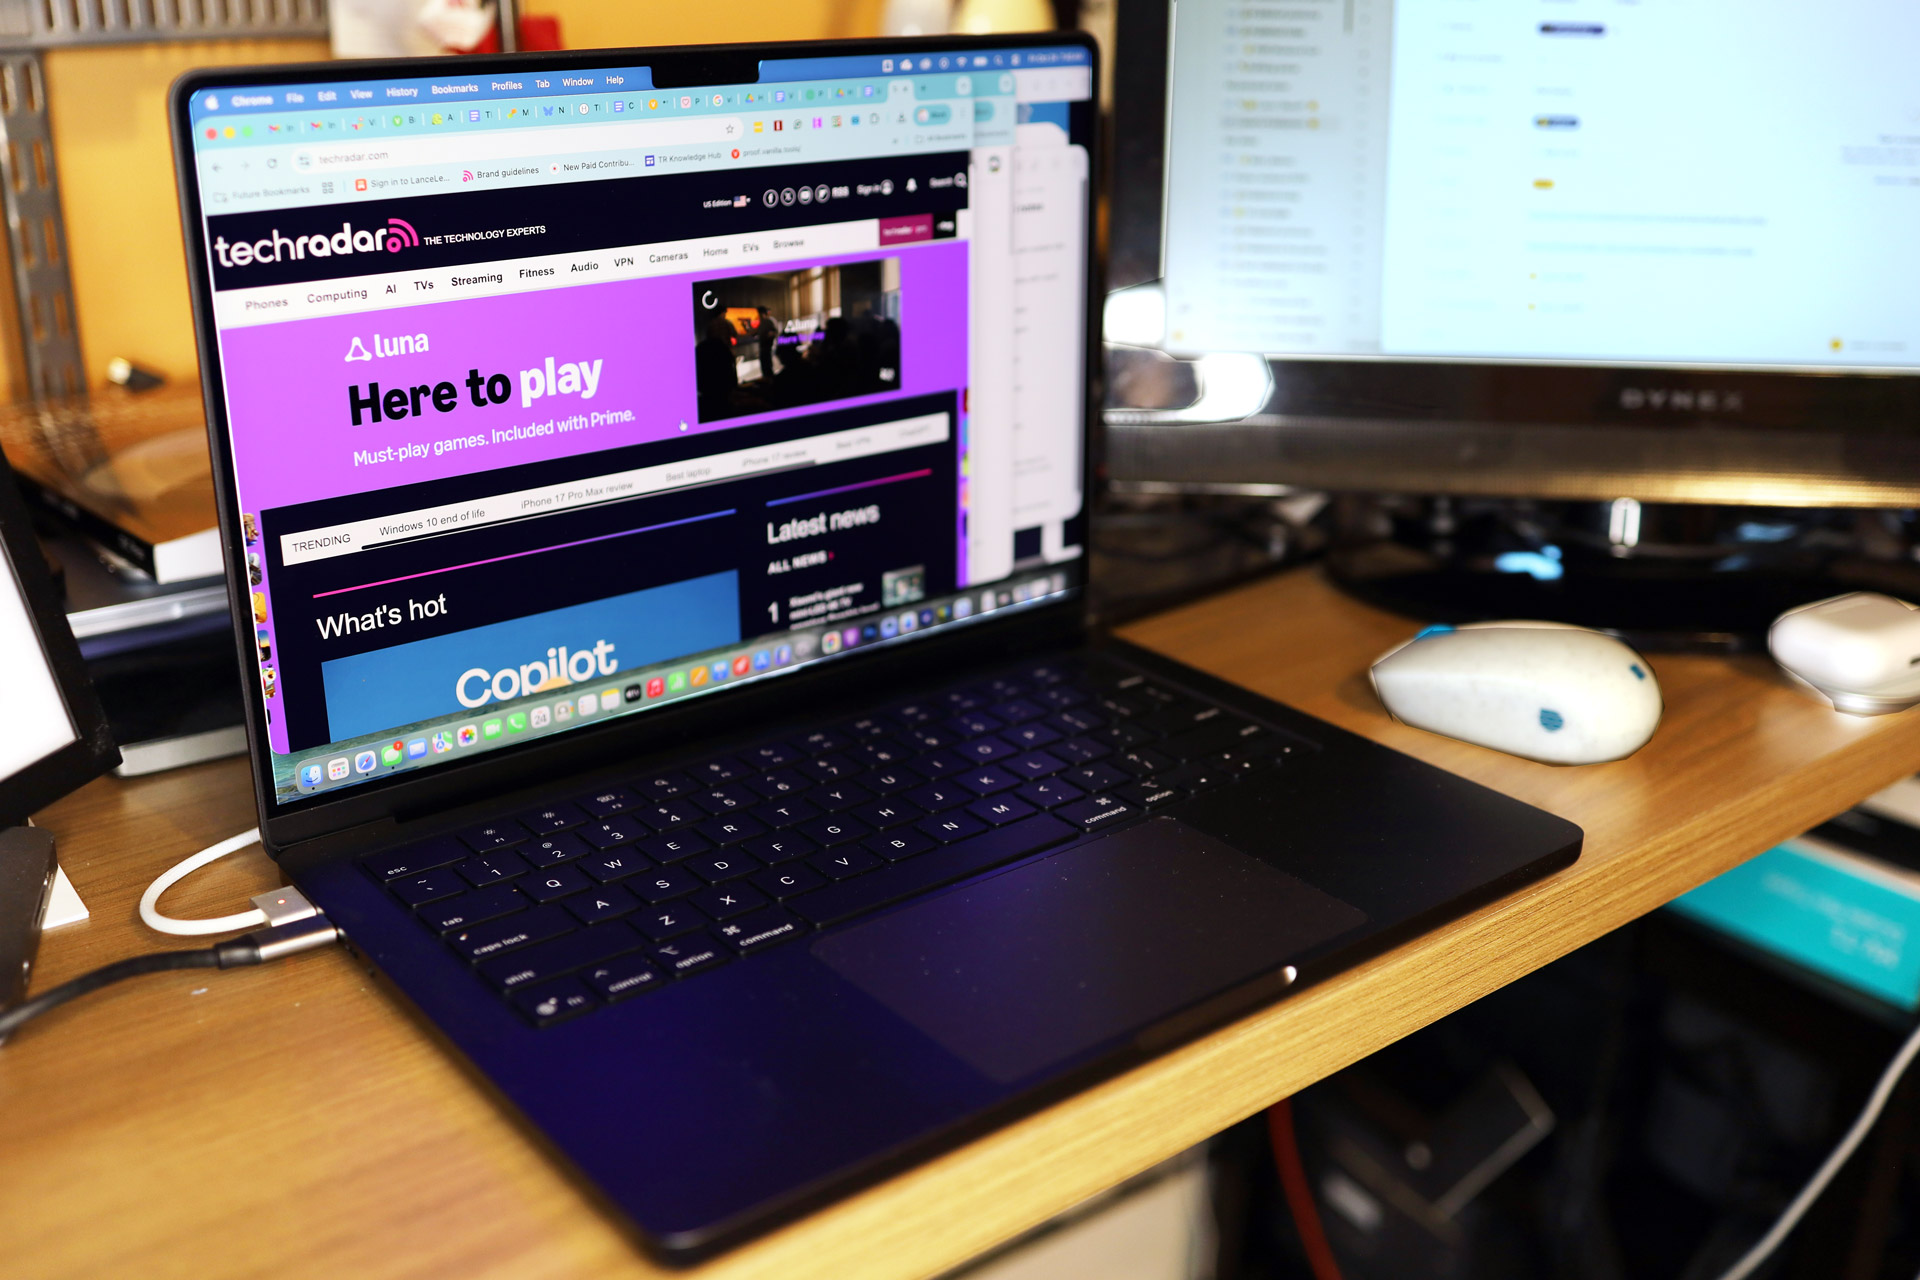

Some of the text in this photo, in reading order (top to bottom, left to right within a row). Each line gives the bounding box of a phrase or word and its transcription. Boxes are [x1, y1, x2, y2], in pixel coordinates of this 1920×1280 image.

[491, 80, 523, 92] Profiles
[535, 79, 551, 89] Tab
[562, 76, 594, 88] Window
[606, 75, 624, 86] Help
[350, 89, 373, 100] View
[386, 86, 418, 98] History
[431, 83, 479, 95] Bookmarks
[231, 94, 274, 108] Chrome
[285, 92, 305, 104] File
[317, 90, 337, 102] Edit
[319, 150, 389, 165] techradar.com
[658, 151, 722, 164] TR Knowledge Hub
[477, 166, 540, 179] Brand guidelines
[563, 163, 579, 172] New
[581, 161, 597, 171] Paid
[370, 178, 389, 190] Sign
[390, 178, 398, 187] in
[400, 177, 409, 185] to
[262, 186, 310, 197] Bookmarks
[423, 225, 546, 246] THE TECHNOLOGY EXPERTS
[214, 222, 388, 268] techradar
[743, 243, 759, 253] EVs
[773, 239, 804, 249] Browse
[649, 251, 689, 264] Cameras
[703, 246, 728, 257] Home
[570, 261, 599, 273] Audio
[614, 257, 634, 268] VPN
[518, 266, 555, 279] Fitness
[413, 279, 434, 291] TVs
[451, 272, 503, 287] Streaming
[385, 284, 397, 294] AI
[306, 288, 368, 304] Computing
[245, 297, 288, 311] Phones
[373, 333, 430, 359] luna
[348, 356, 603, 427] Here to play
[353, 407, 636, 467] Must-play games. Included with Prime.
[666, 466, 711, 482] Best laptop
[521, 482, 633, 510] iPhone 17 Pro Max review
[379, 508, 485, 537] Windows 10 end of life
[766, 505, 881, 545] Latest news
[292, 533, 351, 554] TRENDING
[768, 551, 827, 575] ALL NEWS
[316, 593, 448, 640] What's hot
[768, 601, 779, 624] 1
[456, 640, 618, 708] Copilot
[534, 713, 548, 725] 24
[880, 775, 896, 785] U
[978, 776, 995, 785] K
[830, 791, 843, 800] Y
[934, 792, 944, 801] J
[776, 807, 790, 817] T
[878, 808, 895, 818] H
[991, 804, 1010, 815] M
[1085, 806, 1127, 824] command
[670, 814, 681, 823] 4
[723, 824, 738, 833] R
[827, 825, 841, 834] G
[942, 821, 960, 832] N
[611, 832, 624, 841] 3
[666, 841, 681, 851] E
[772, 842, 784, 852] F
[890, 839, 906, 849] B
[552, 849, 566, 859] 2
[603, 858, 623, 869] W
[714, 861, 729, 870] D
[834, 856, 849, 867] V
[387, 865, 408, 876] esc
[491, 868, 502, 877] 1
[546, 879, 562, 889] Q
[655, 879, 670, 889] S
[780, 875, 795, 885] C
[595, 899, 610, 910] A
[719, 894, 737, 906] X
[442, 916, 464, 927] tab
[657, 915, 675, 926] Z
[739, 922, 794, 947] command
[473, 933, 529, 956] caps lock
[675, 951, 715, 969] option
[608, 971, 654, 993] control
